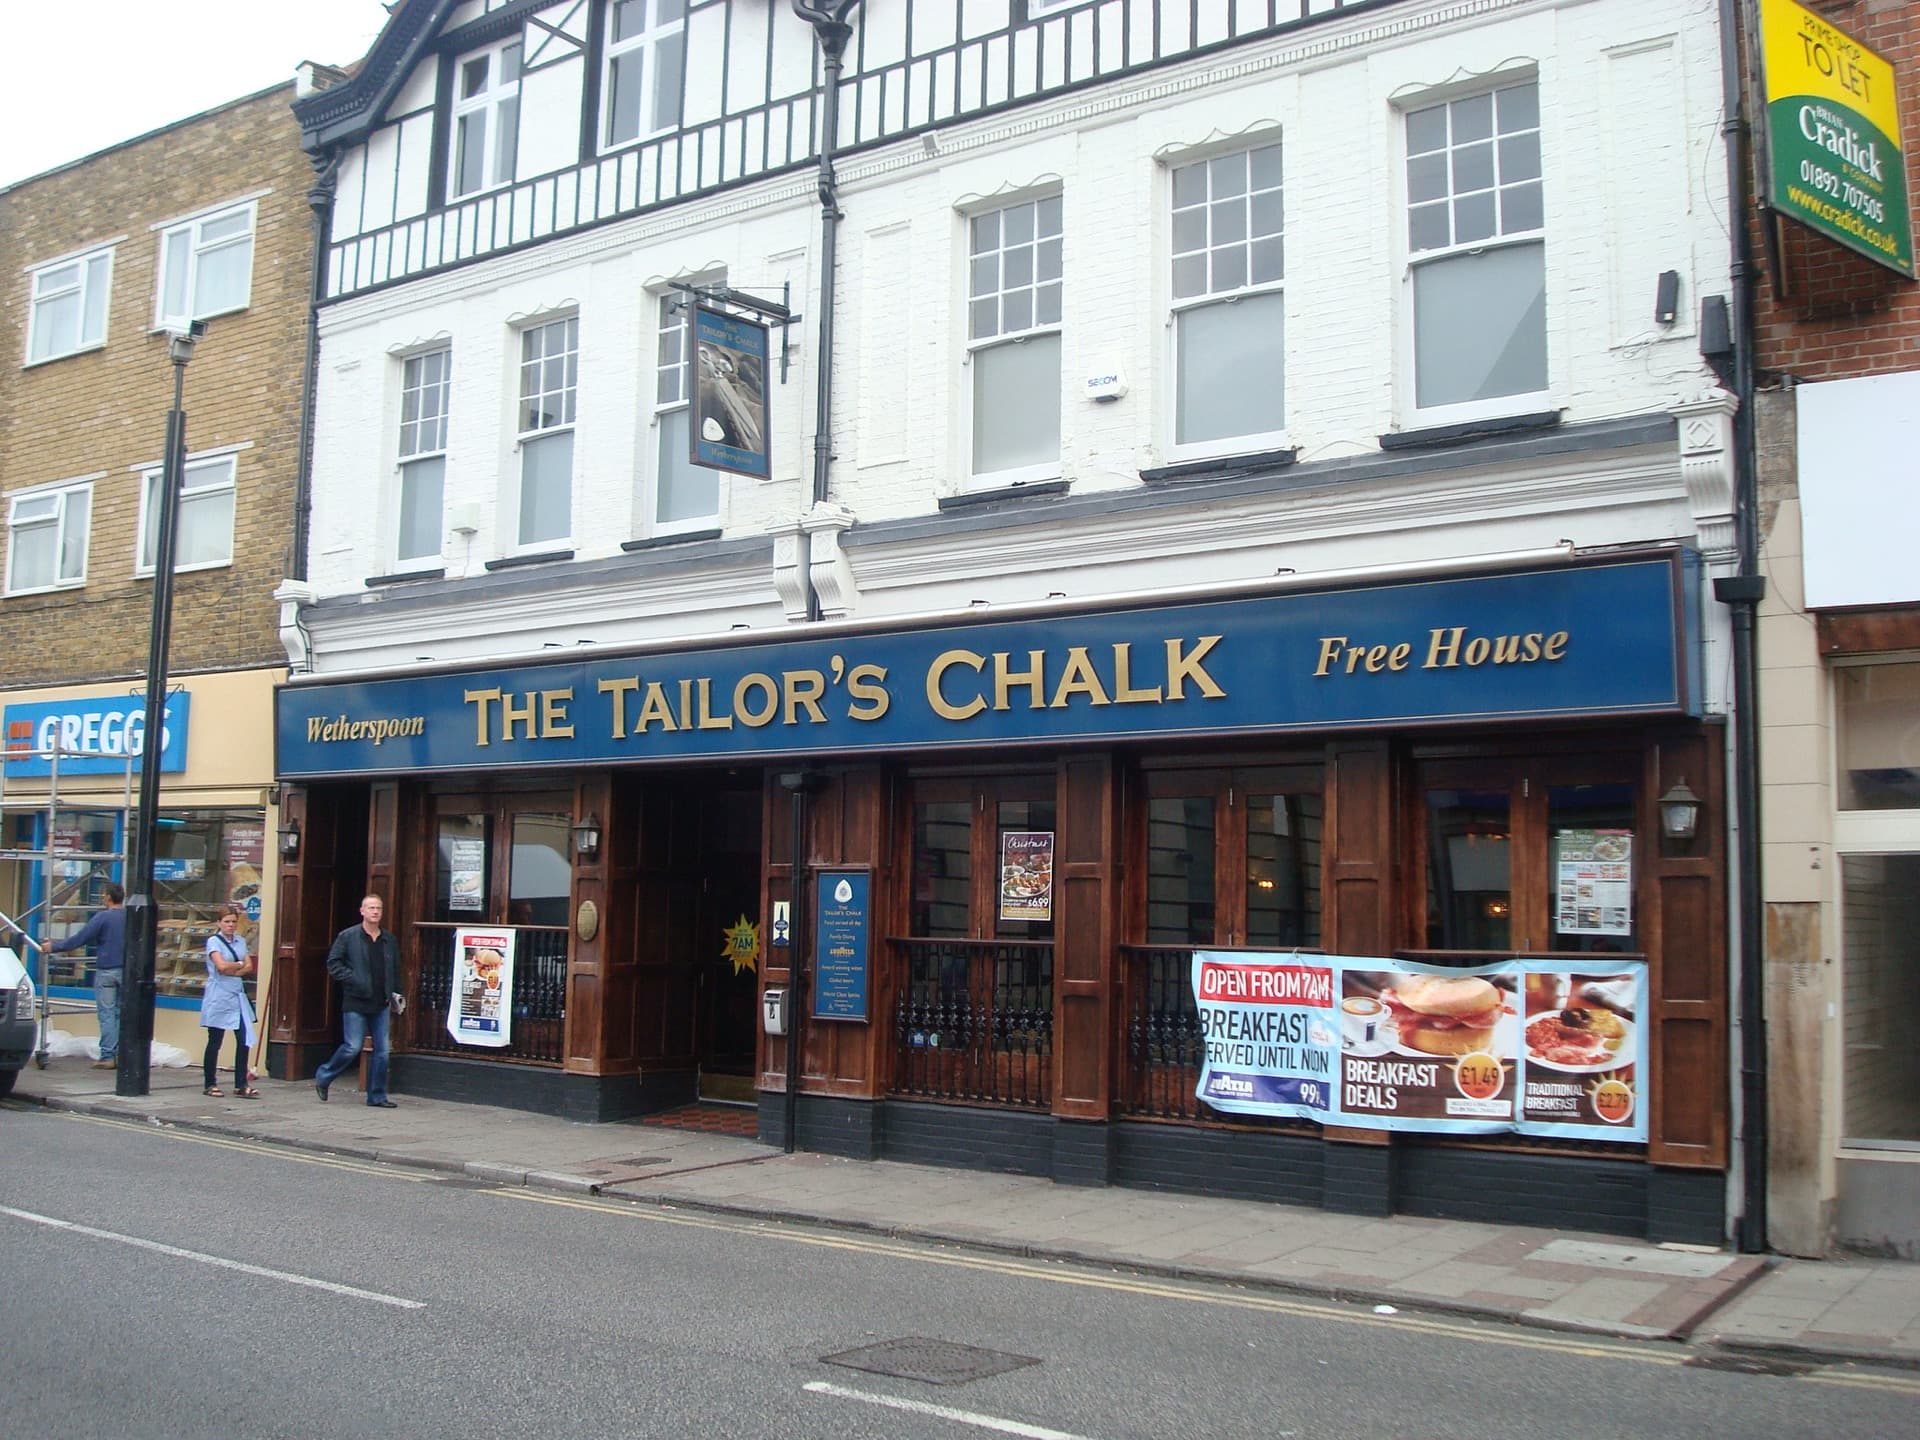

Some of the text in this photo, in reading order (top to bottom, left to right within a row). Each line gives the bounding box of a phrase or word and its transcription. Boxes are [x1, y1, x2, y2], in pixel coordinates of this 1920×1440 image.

[1797, 31, 1871, 103] TO LET
[1799, 105, 1883, 182] Cradick
[1800, 159, 1884, 223] 01892 707505
[1787, 185, 1898, 256] www.cradick.co.uk
[1312, 625, 1570, 677] Free House
[464, 634, 1227, 748] THE TAILOR'S CHALK
[305, 713, 425, 747] Wetherspoon
[732, 937, 754, 950] 7AM
[1204, 968, 1330, 1001] OPEN FROM 7AM
[1199, 1007, 1309, 1045] BREAKFAST
[1206, 1041, 1254, 1067] ERVED
[1258, 1045, 1298, 1070] UNTIL
[1346, 1058, 1440, 1088] BREAKFAST
[1461, 1066, 1499, 1086] £1.49
[1527, 1082, 1585, 1097] TRADITIONAL
[1346, 1083, 1398, 1110] DEALS
[1525, 1096, 1579, 1110] BREAKFAST
